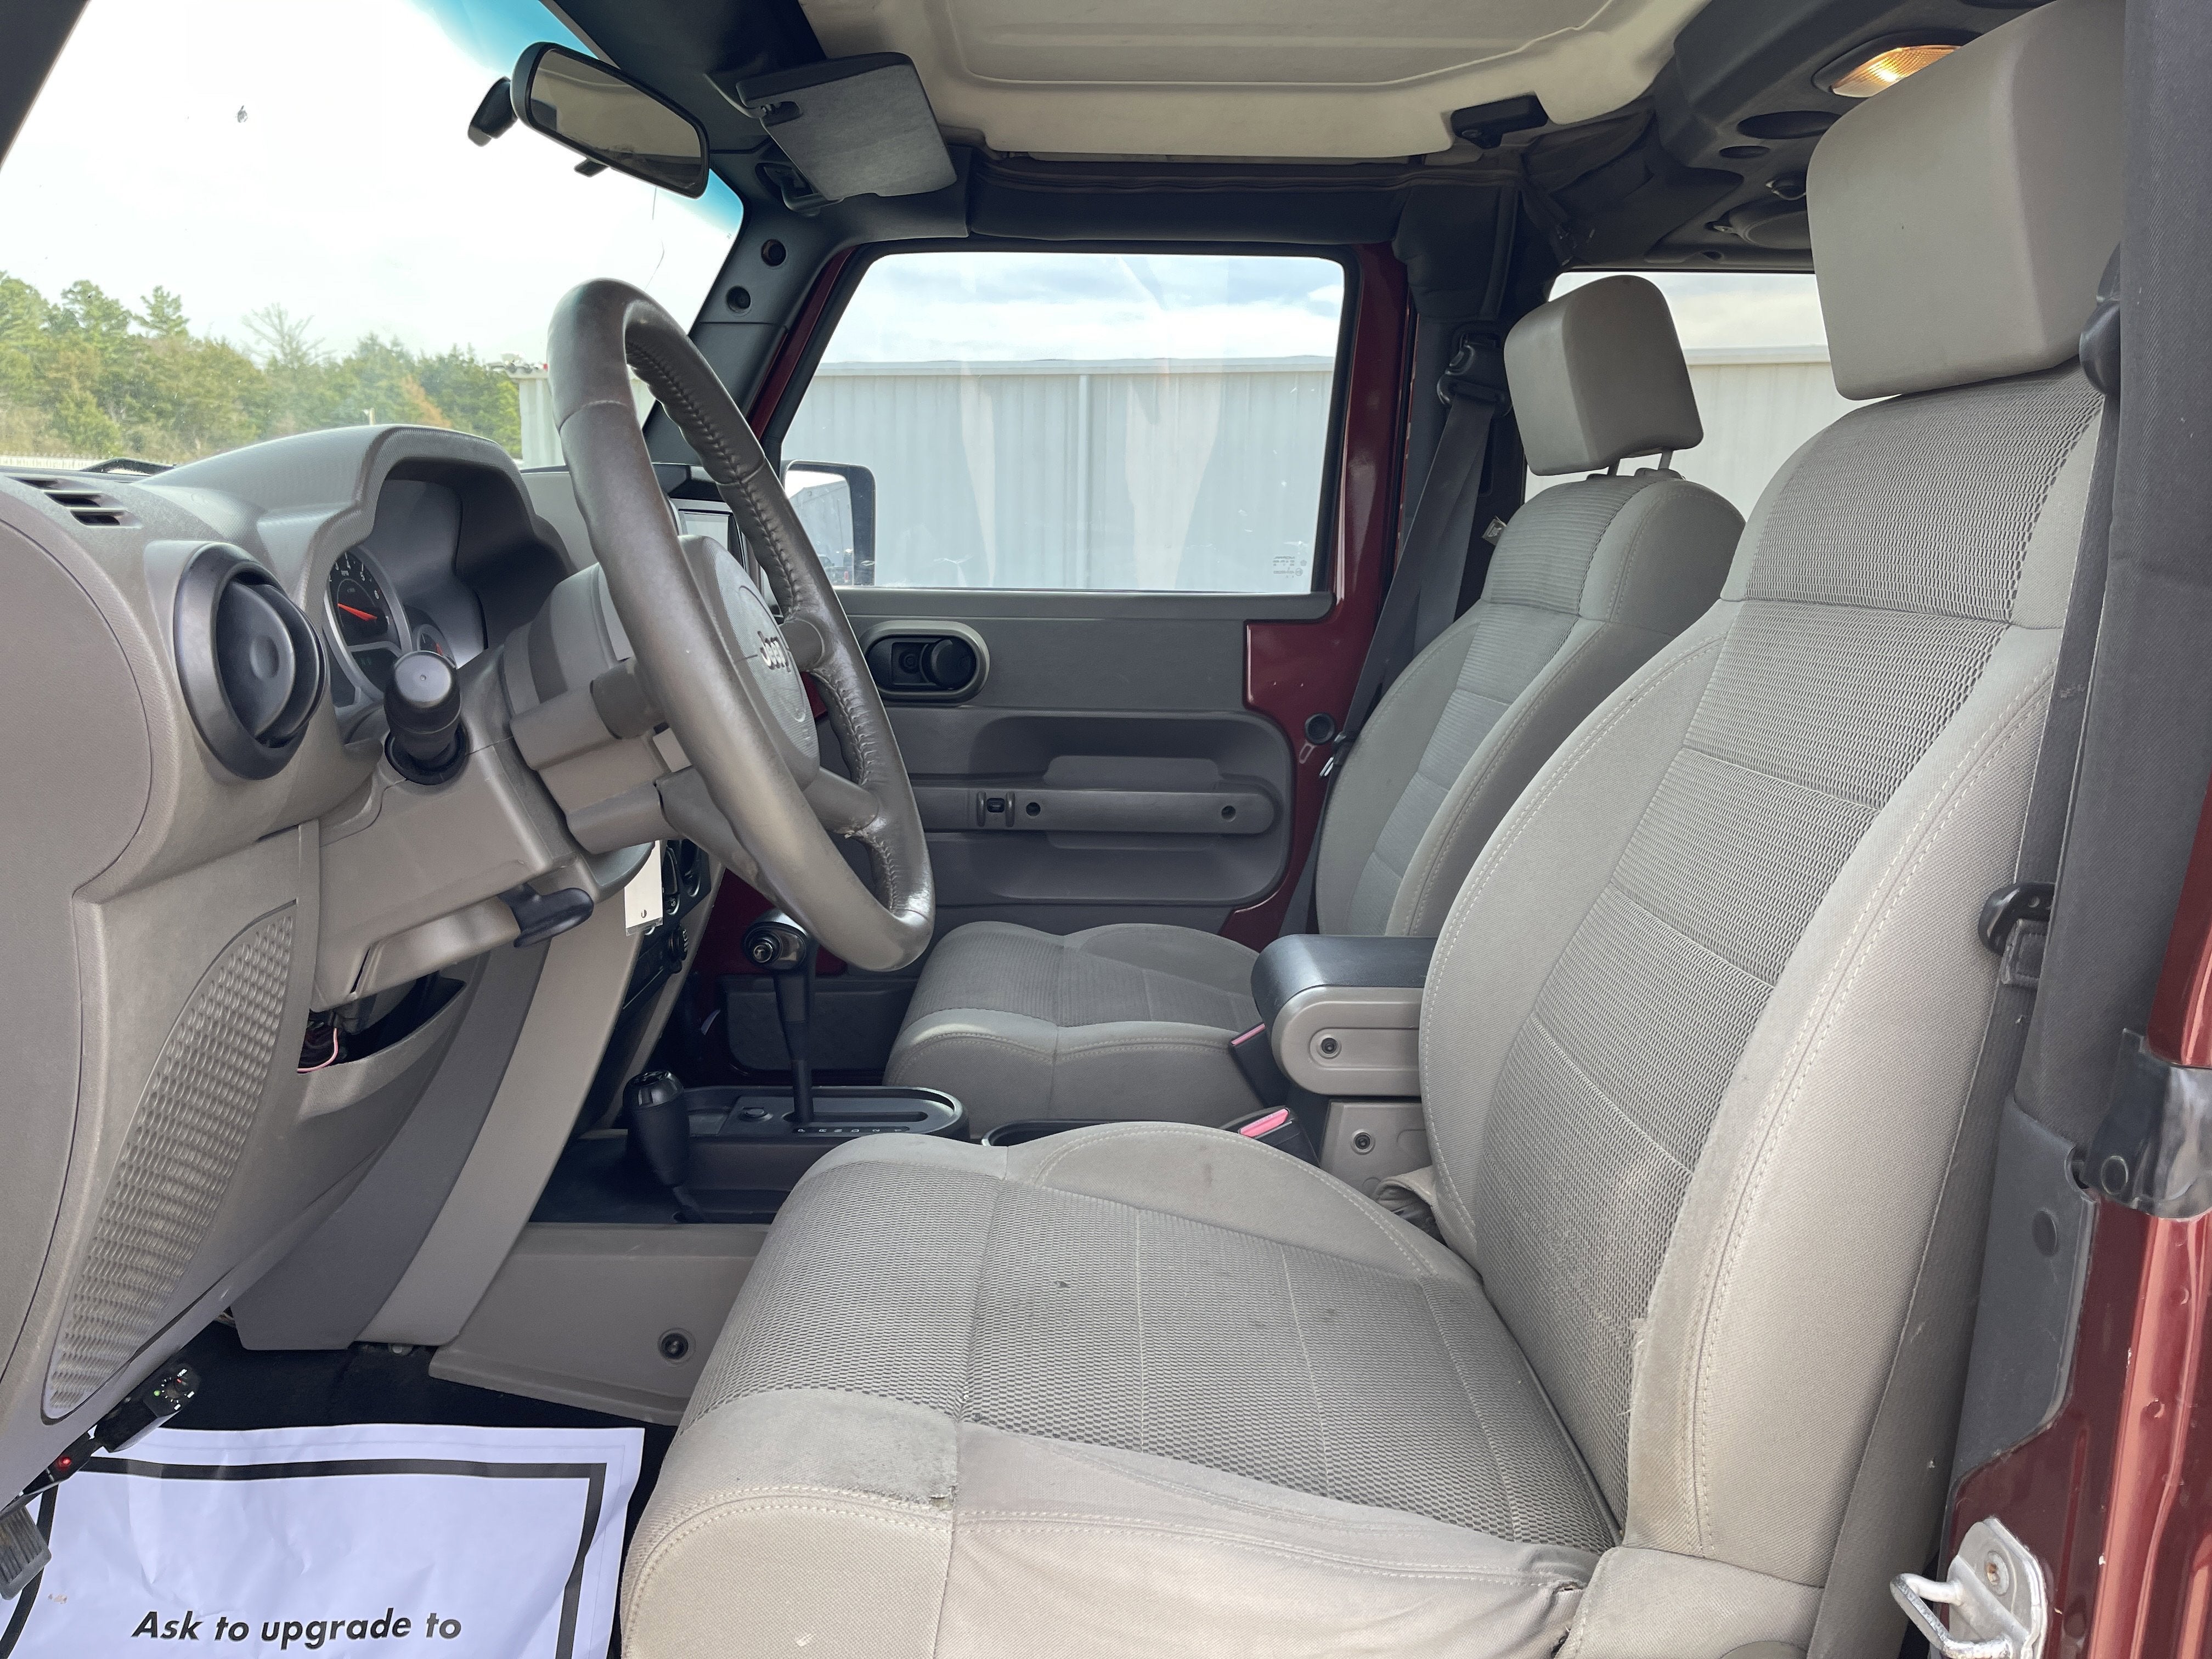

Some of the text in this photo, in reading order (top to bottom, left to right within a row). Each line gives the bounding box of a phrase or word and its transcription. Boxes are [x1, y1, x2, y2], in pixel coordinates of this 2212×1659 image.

[757, 631, 791, 673] Jeep
[131, 1607, 461, 1650] Ask to upgrade to
